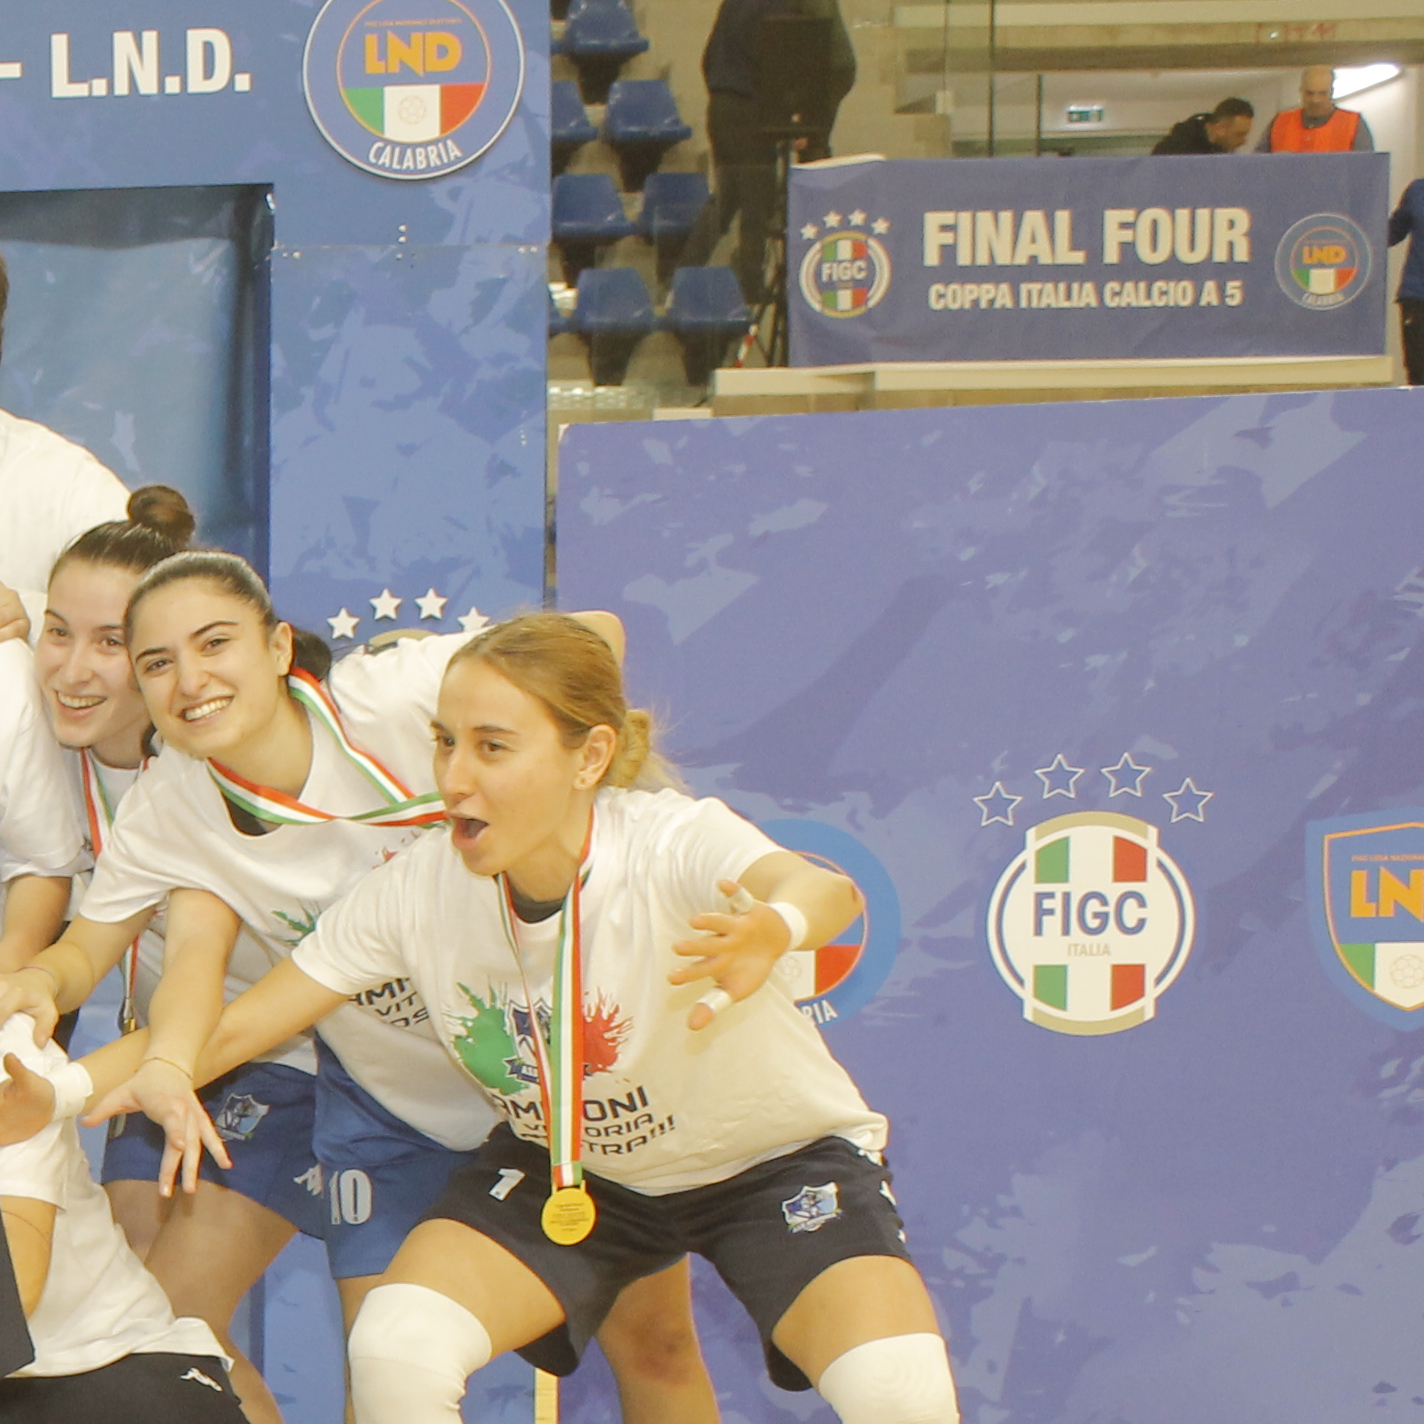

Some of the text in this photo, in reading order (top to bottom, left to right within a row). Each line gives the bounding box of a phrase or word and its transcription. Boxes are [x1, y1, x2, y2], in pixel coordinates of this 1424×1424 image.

[50, 27, 251, 99] L.N.D.
[365, 30, 462, 77] LND
[369, 139, 463, 170] CALABRIA
[924, 207, 1251, 267] FINAL FOUR
[822, 261, 868, 282] FIGC
[928, 280, 1244, 310] COPPA ITALIA CALCIO A 5
[1033, 890, 1148, 937] FIGC
[1351, 867, 1424, 923] LN
[1067, 942, 1111, 958] ITALIA
[330, 1168, 373, 1226] 10
